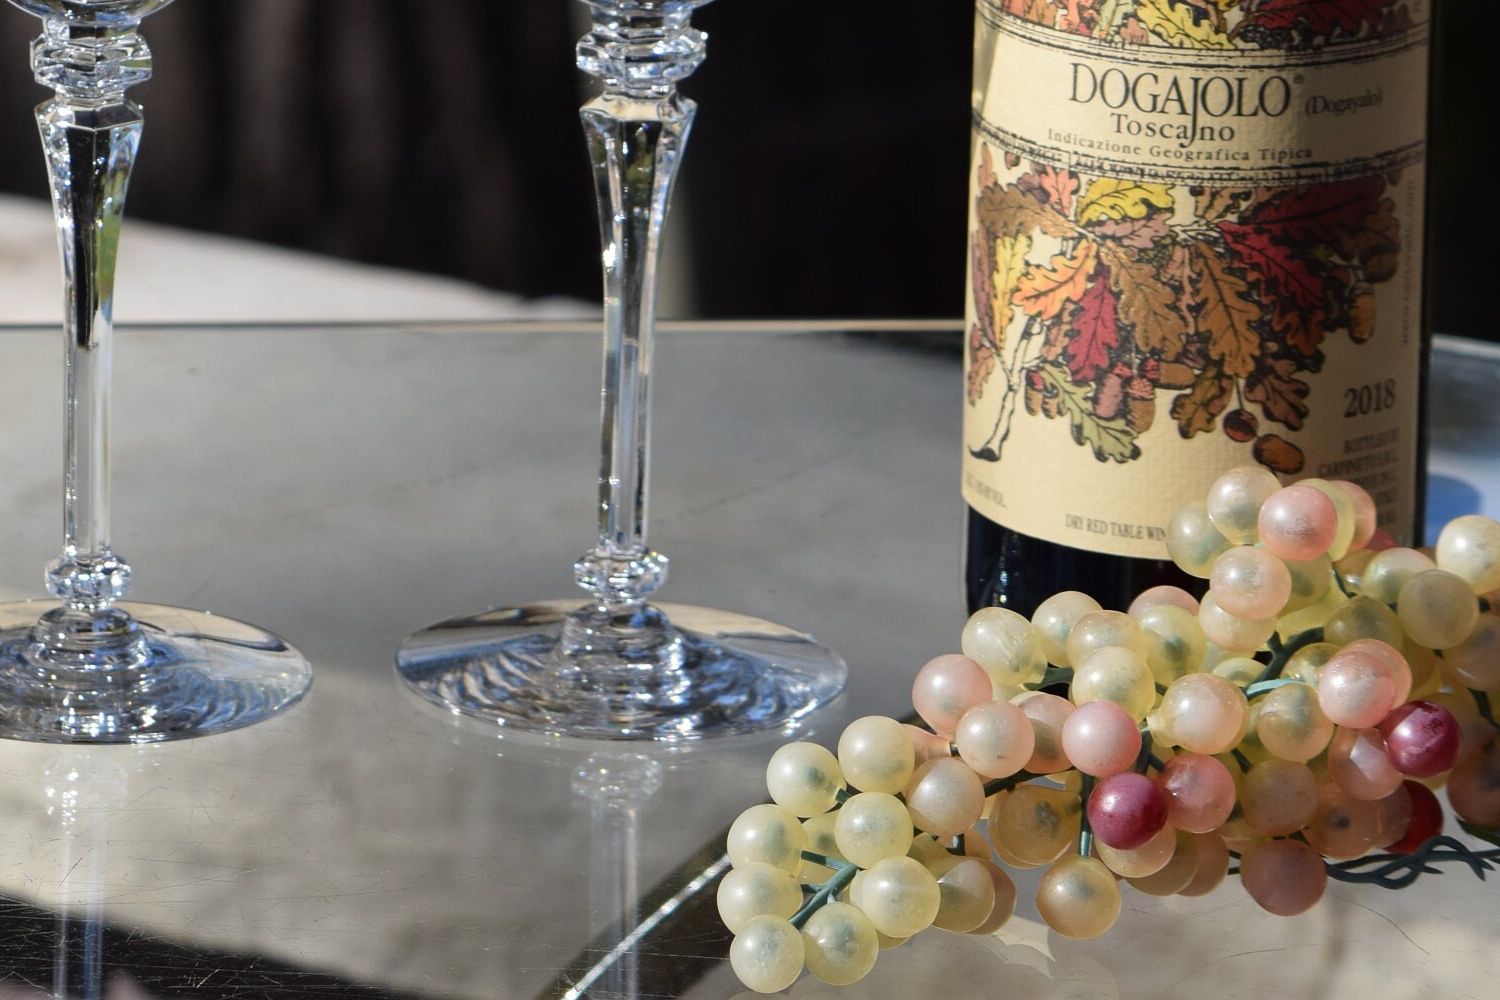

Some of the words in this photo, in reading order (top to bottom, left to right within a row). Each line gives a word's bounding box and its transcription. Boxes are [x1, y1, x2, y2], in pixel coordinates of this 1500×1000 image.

[1068, 62, 1291, 147] DOGAJOLO
[1110, 111, 1235, 141] Toscano
[1047, 128, 1142, 156] Indicazione
[1148, 145, 1250, 162] Geografica
[1258, 146, 1313, 161] Tipica
[1343, 378, 1396, 418] 2018
[1065, 513, 1083, 530] DRY
[1086, 518, 1108, 534] RED
[1110, 521, 1145, 539] TABLE
[1146, 525, 1167, 542] WIN
